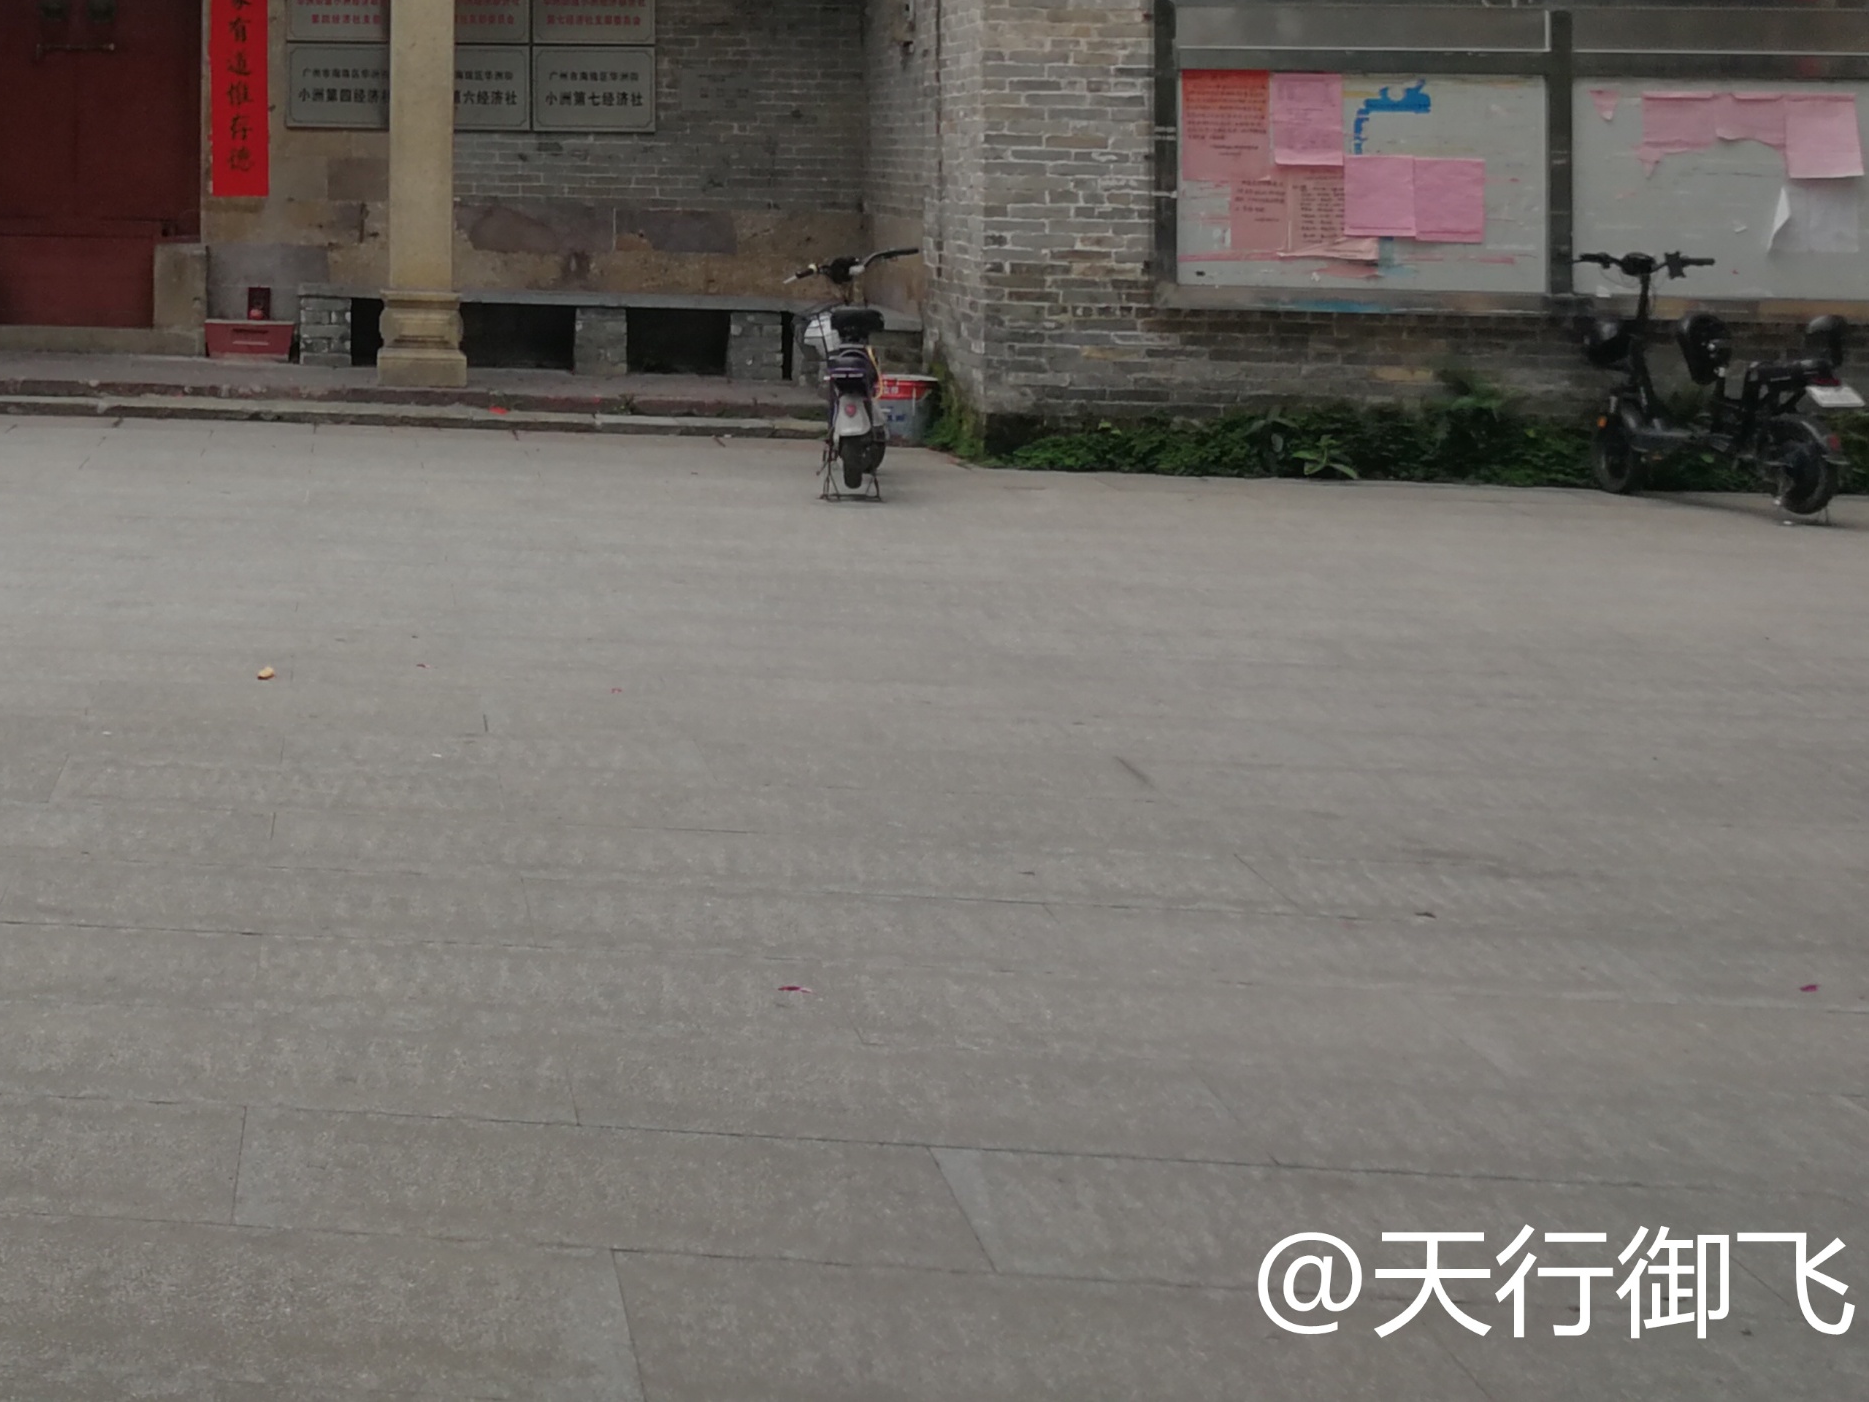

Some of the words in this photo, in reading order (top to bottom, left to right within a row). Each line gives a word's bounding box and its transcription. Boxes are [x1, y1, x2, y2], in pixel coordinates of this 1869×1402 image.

[545, 91, 644, 107] 小洲第七经济社
